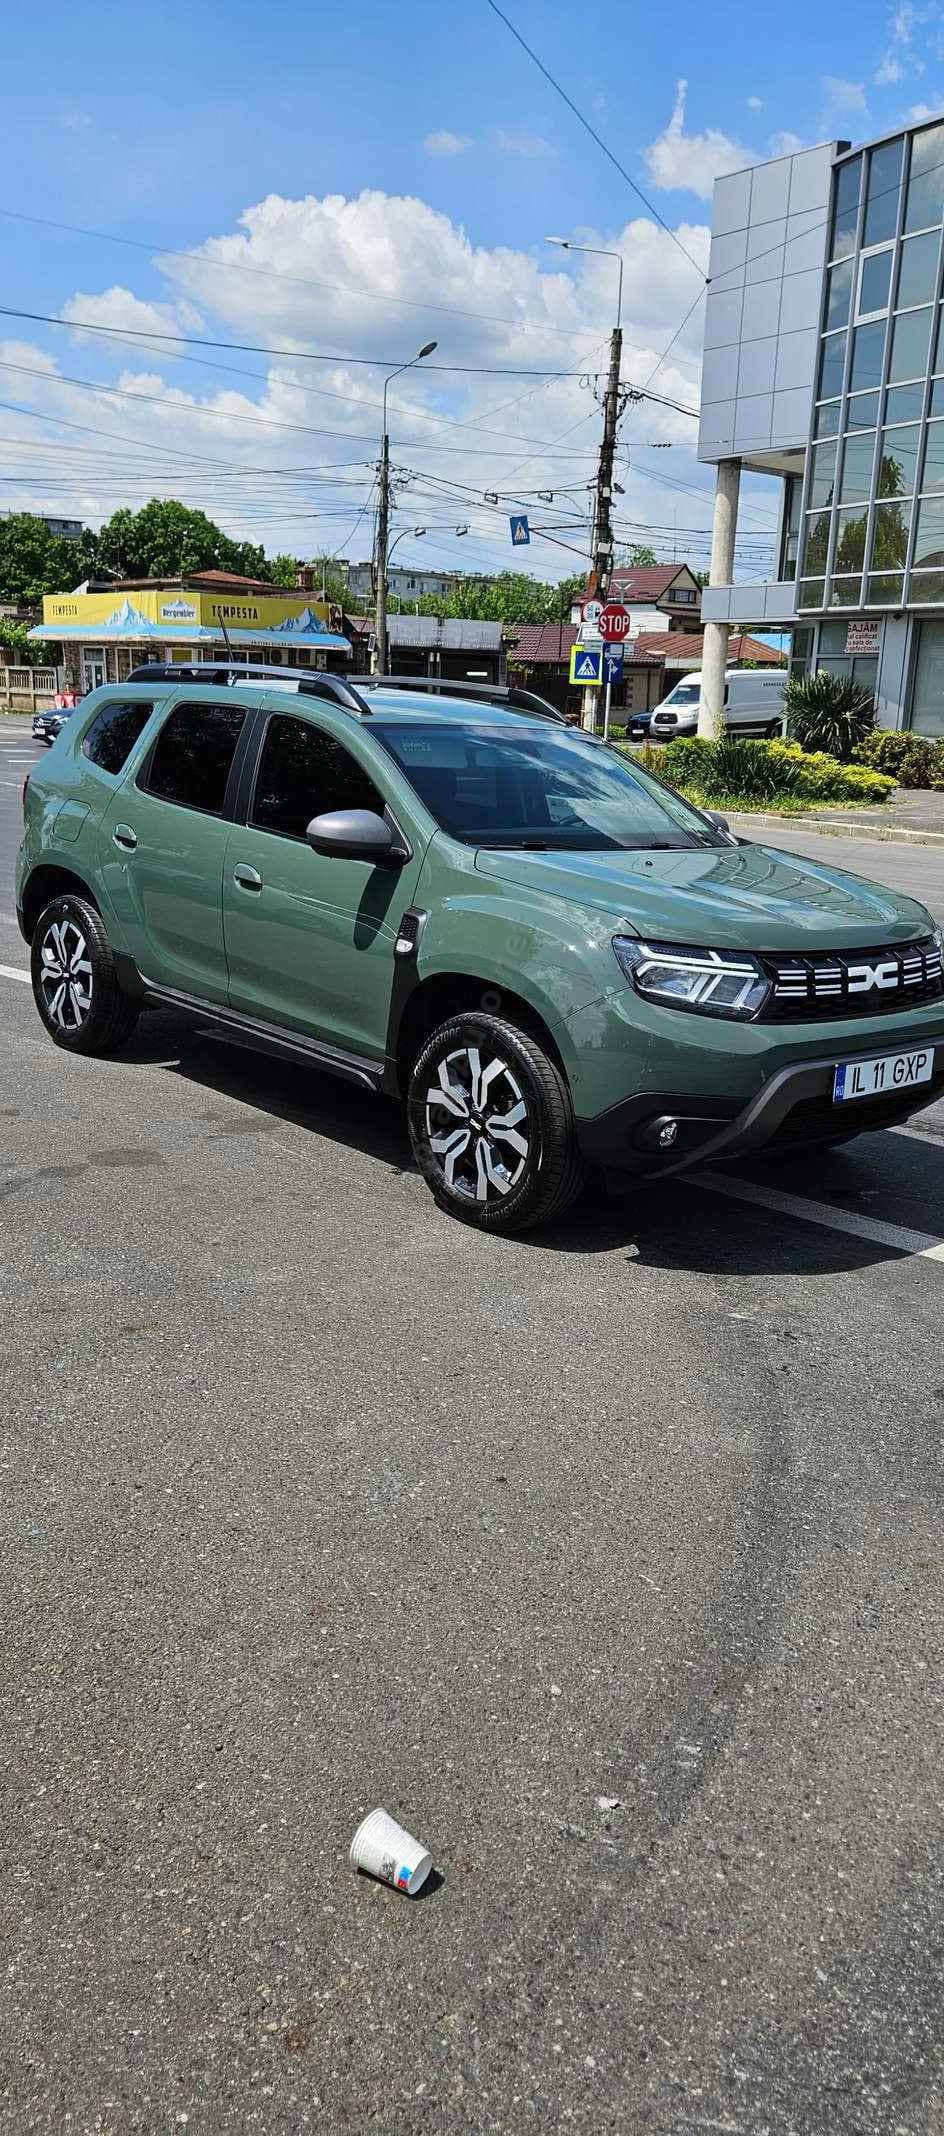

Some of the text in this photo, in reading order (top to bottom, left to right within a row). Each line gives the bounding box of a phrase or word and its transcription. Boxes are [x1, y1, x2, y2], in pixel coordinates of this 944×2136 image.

[52, 605, 78, 616] TEMPESTA
[212, 605, 258, 620] TEMPESTA
[600, 615, 629, 632] STOP
[851, 1053, 927, 1094] IL 11 GXP
